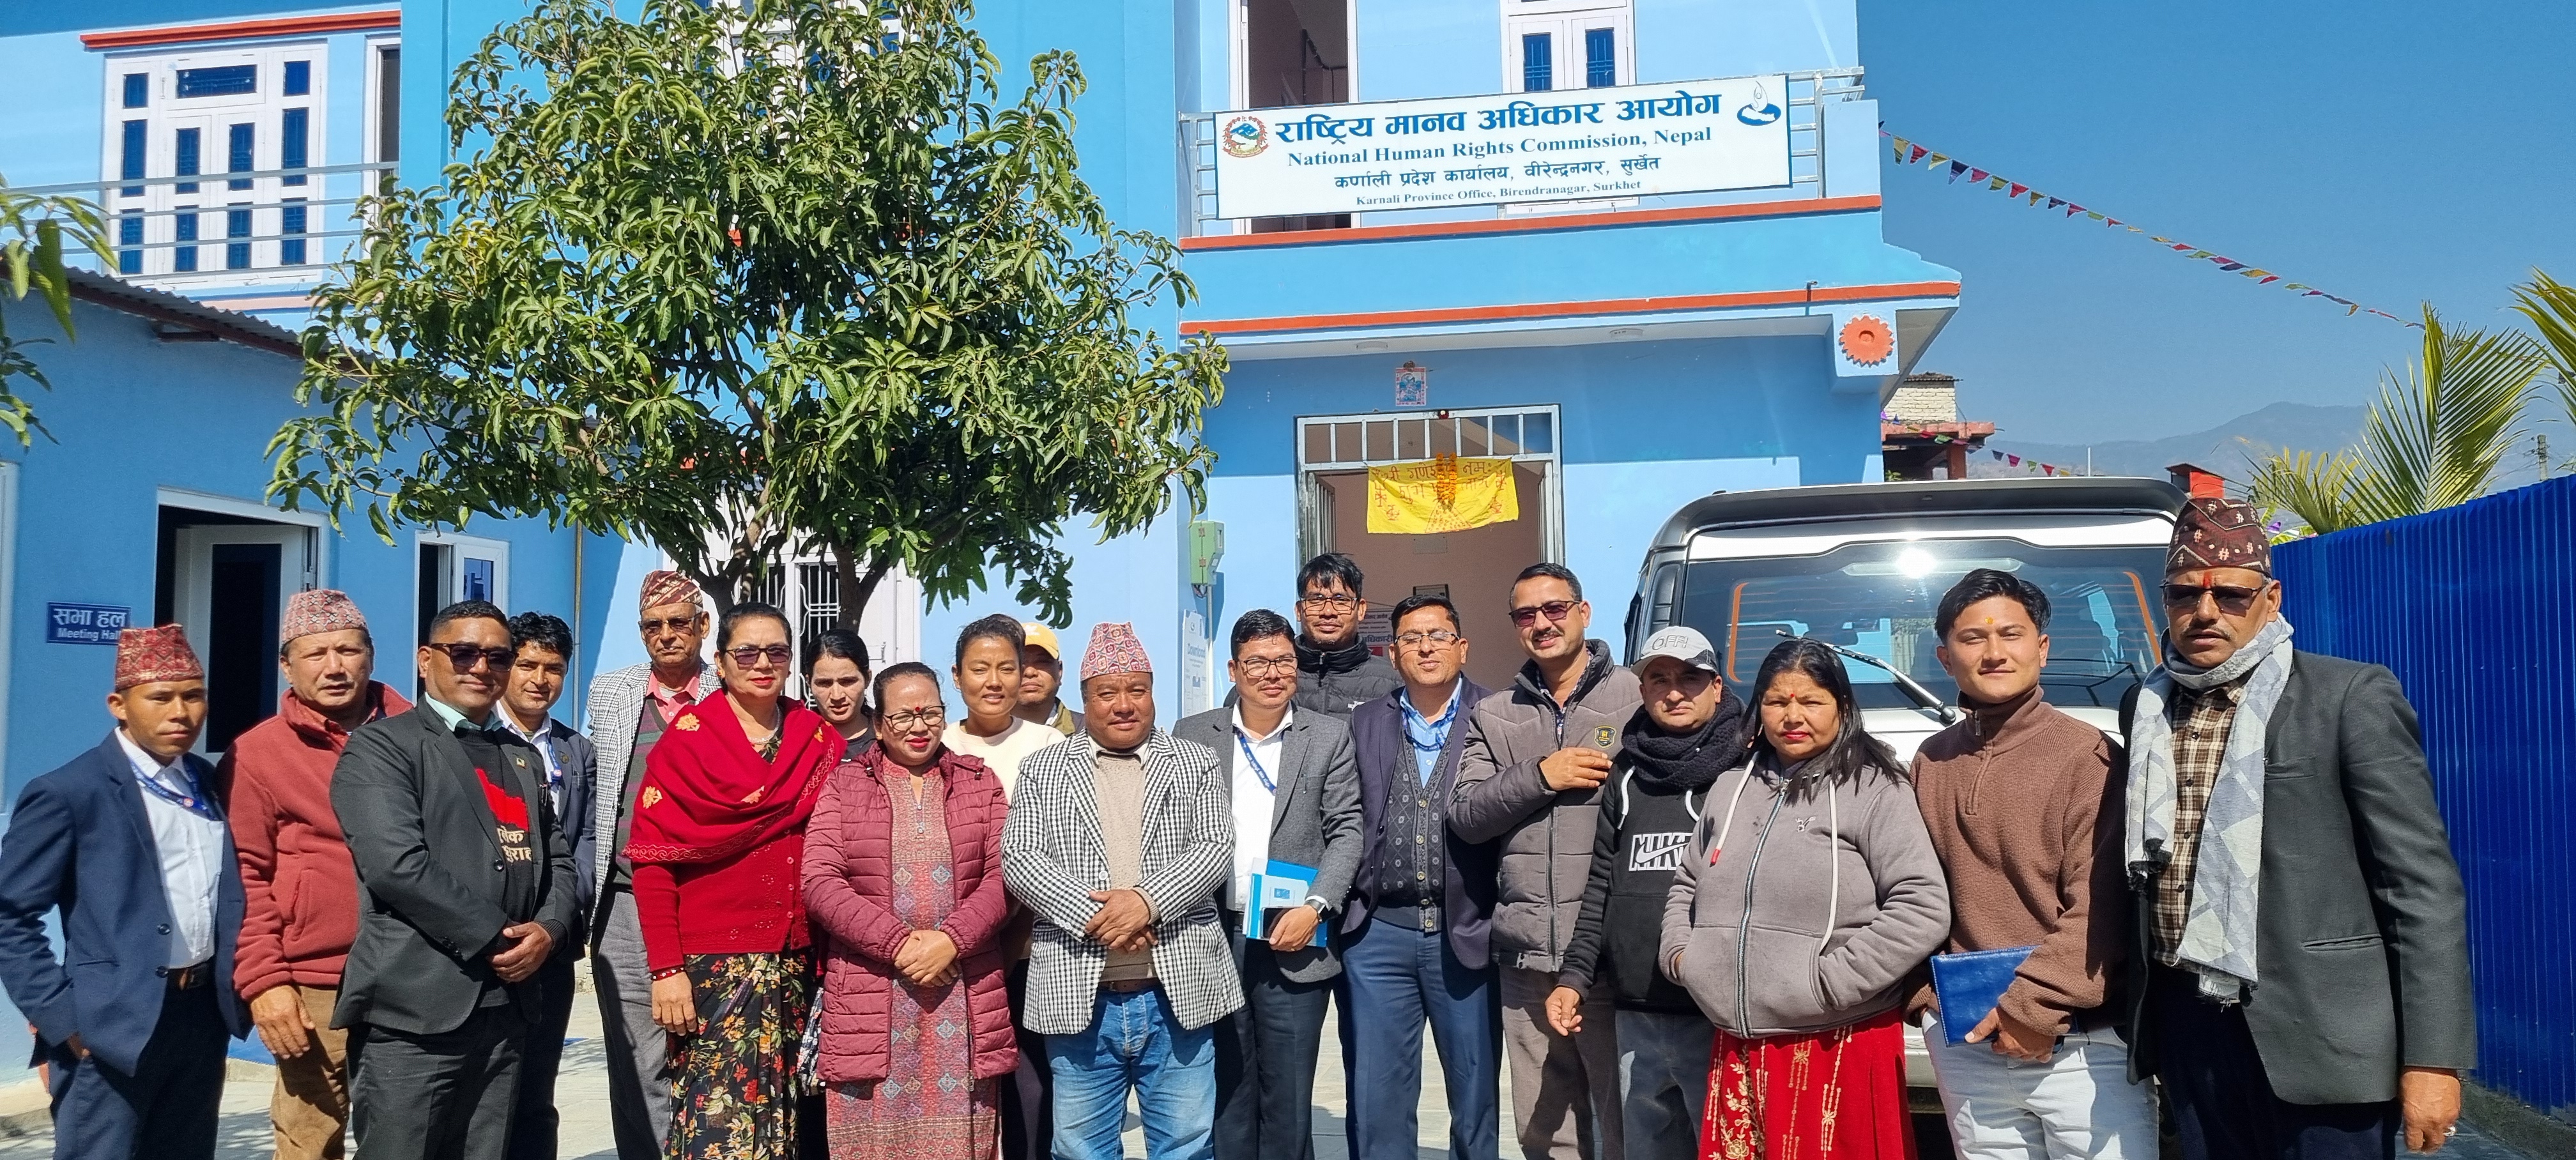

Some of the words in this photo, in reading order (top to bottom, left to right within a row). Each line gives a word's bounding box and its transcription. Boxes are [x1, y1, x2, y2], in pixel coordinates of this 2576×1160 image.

[1275, 114, 1375, 144] राष्ट्रिय
[1385, 112, 1467, 135] मानव
[1478, 101, 1605, 130] अधिकार
[1616, 90, 1722, 121] आयोग
[1289, 149, 1367, 165] National
[1376, 147, 1445, 161] Human
[1453, 142, 1514, 158] Rights
[1521, 134, 1646, 152] Commission,
[1655, 127, 1710, 146] Nepal
[1335, 171, 1392, 188] कर्णाली
[1400, 169, 1436, 186] प्रदेश
[1444, 164, 1513, 181] कार्यालय,
[1524, 161, 1609, 178] वीरेन्द्रनगर,
[1620, 154, 1661, 176] सुर्खेत
[1356, 195, 1400, 205] Karnali
[1404, 194, 1453, 202] Province
[1457, 190, 1496, 199] Office,
[1500, 186, 1590, 197] Birendranagar,
[1593, 181, 1641, 190] Surkhet
[53, 608, 93, 625] सभा
[96, 611, 126, 628] हल
[57, 627, 99, 641] Meeting
[1652, 635, 1689, 651] OFF!
